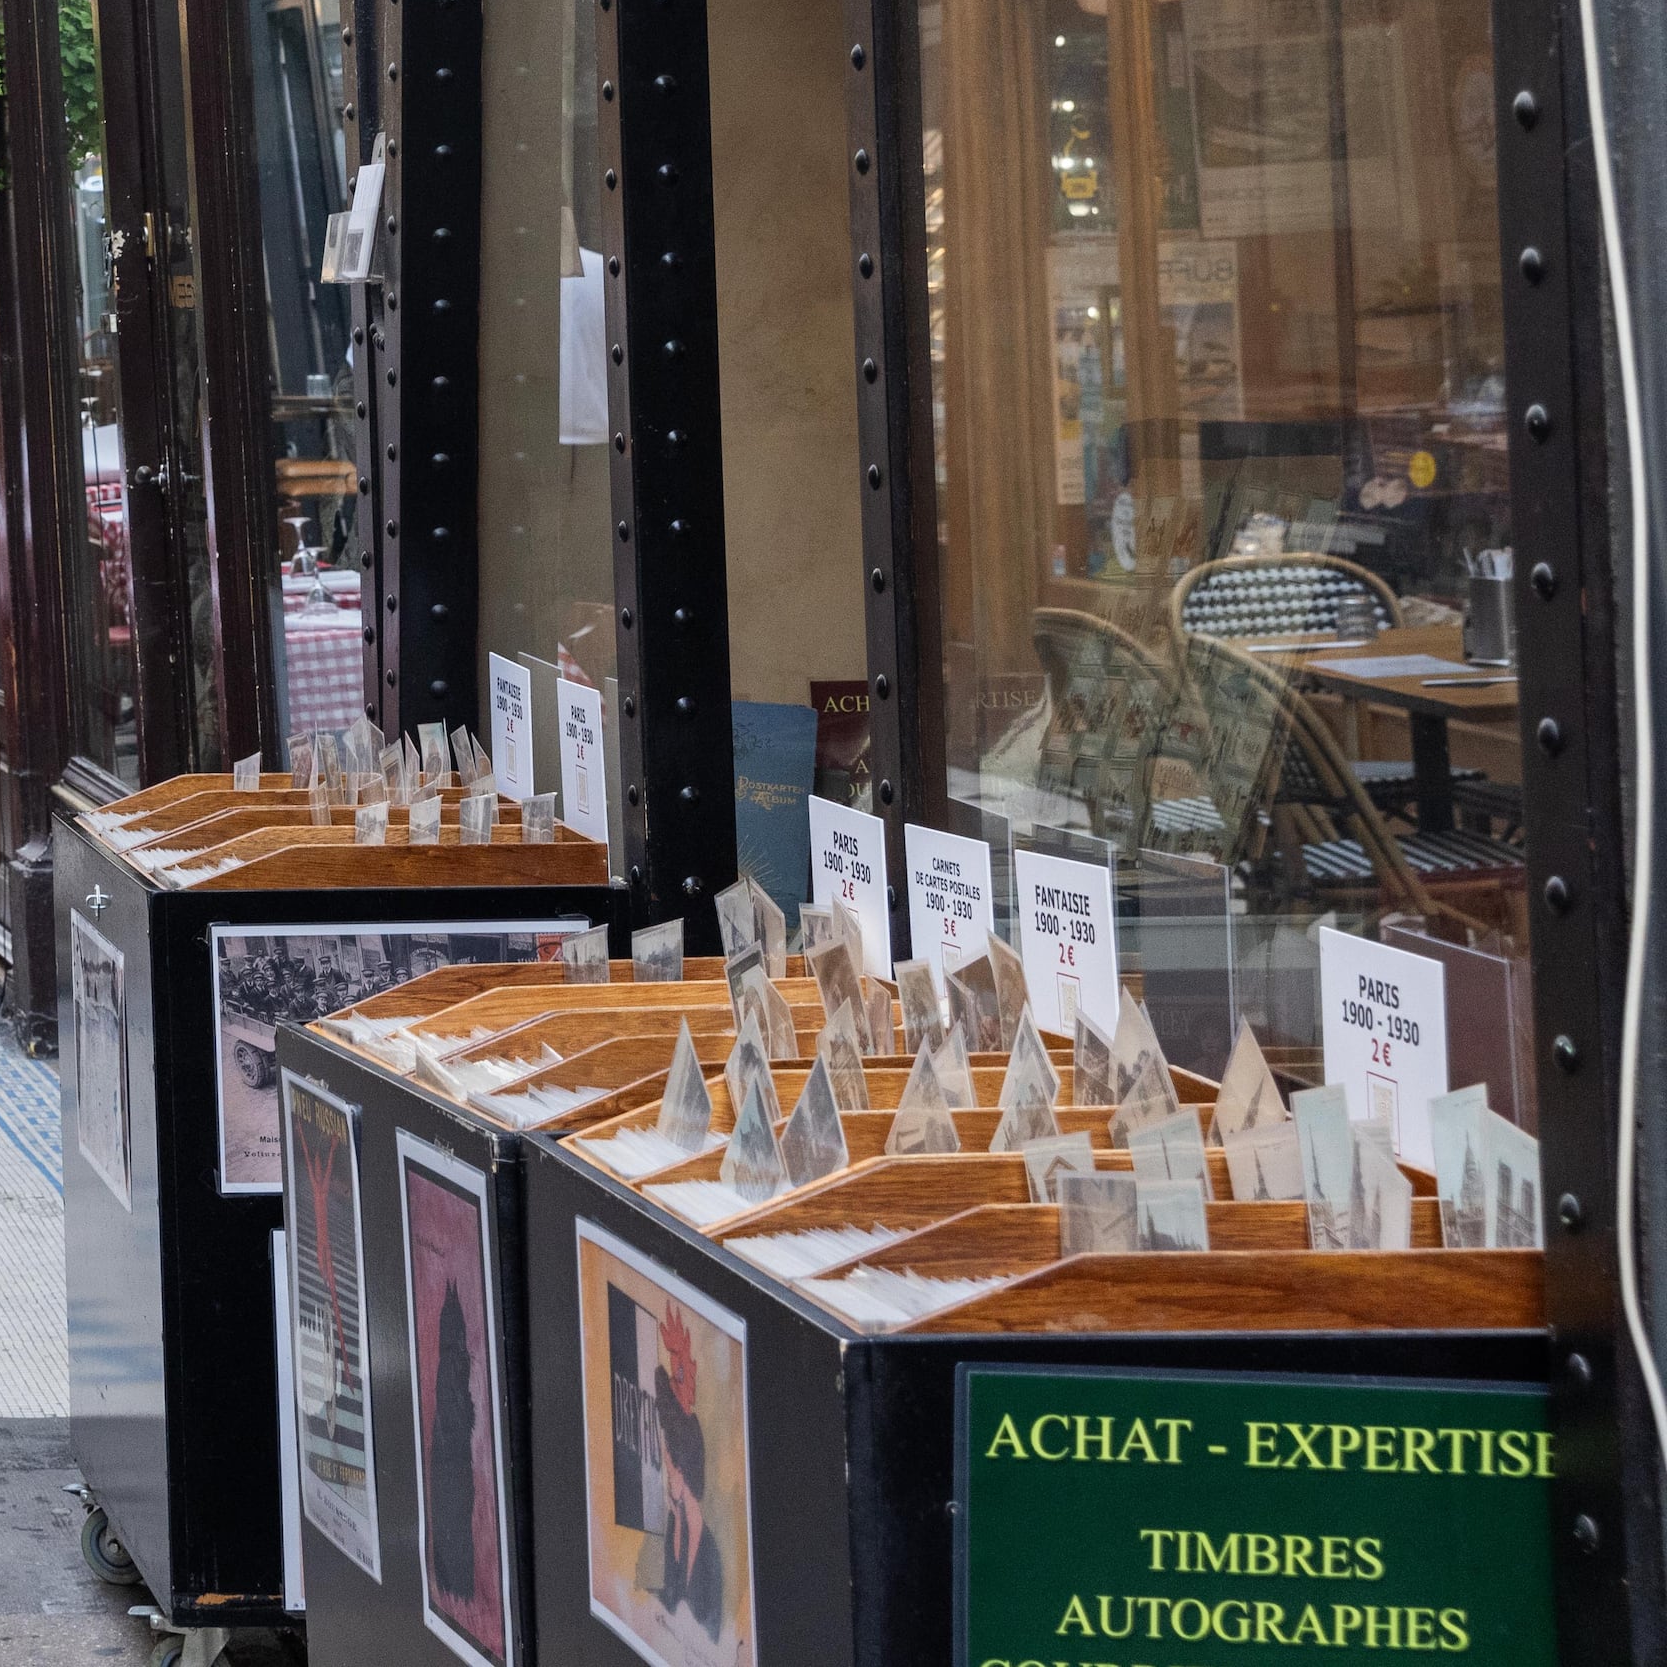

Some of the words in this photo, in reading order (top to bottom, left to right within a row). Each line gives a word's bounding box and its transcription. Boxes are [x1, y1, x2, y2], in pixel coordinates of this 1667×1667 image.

[833, 831, 859, 857] PARIS
[823, 850, 844, 875] 1900
[850, 859, 871, 884] 1930
[932, 857, 961, 877] CARNETS
[915, 870, 924, 885] DE
[924, 873, 949, 892] CARTES
[949, 880, 981, 901] POSTALES
[1035, 884, 1091, 917] FANTAISIE
[925, 892, 945, 913] 1900
[952, 899, 973, 920] 1930
[1034, 911, 1060, 937] 1900
[1069, 919, 1096, 945] 1930
[1359, 974, 1399, 1009] PARIS
[1342, 998, 1373, 1031] 1900
[1387, 1014, 1420, 1046] 1930
[984, 1413, 1192, 1464] ACHAT
[1140, 1529, 1386, 1581] TIMBRES
[1054, 1595, 1471, 1652] AUTOGRAPHES
